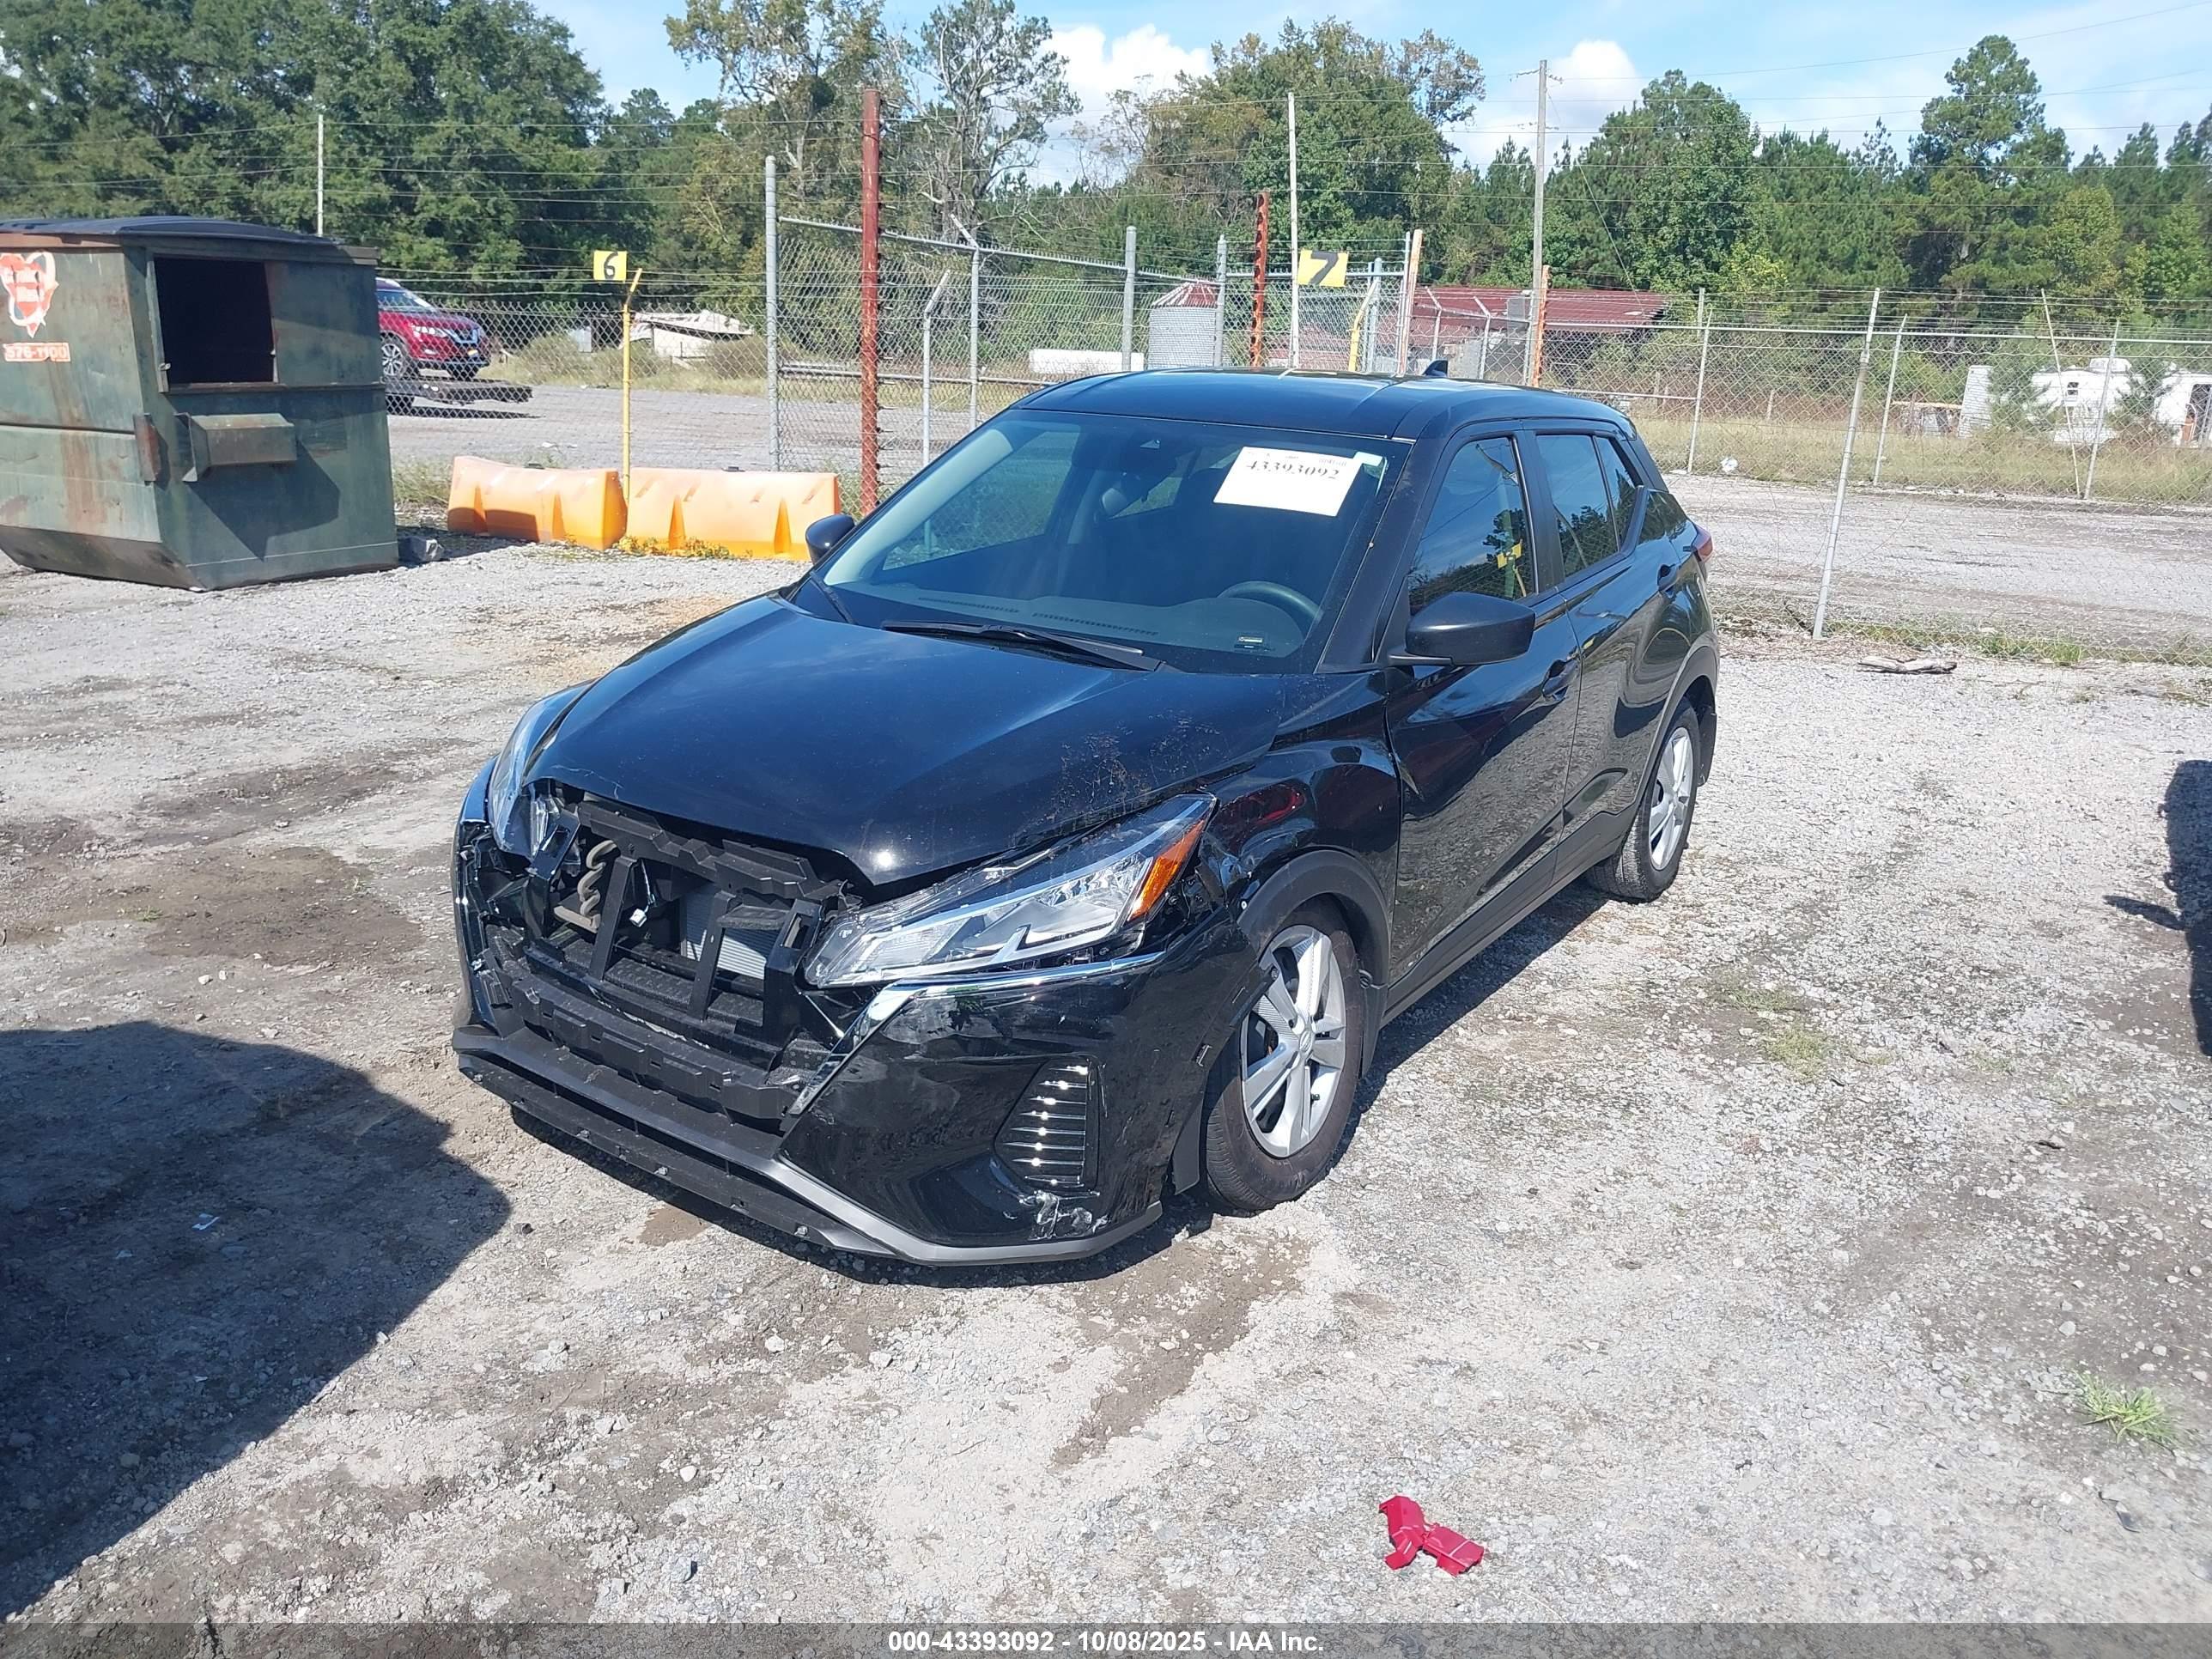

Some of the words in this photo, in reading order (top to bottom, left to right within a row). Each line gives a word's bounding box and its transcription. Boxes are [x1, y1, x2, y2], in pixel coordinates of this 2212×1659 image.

[604, 251, 618, 280] 6
[1309, 249, 1340, 286] 7
[1246, 460, 1340, 480] 43393092
